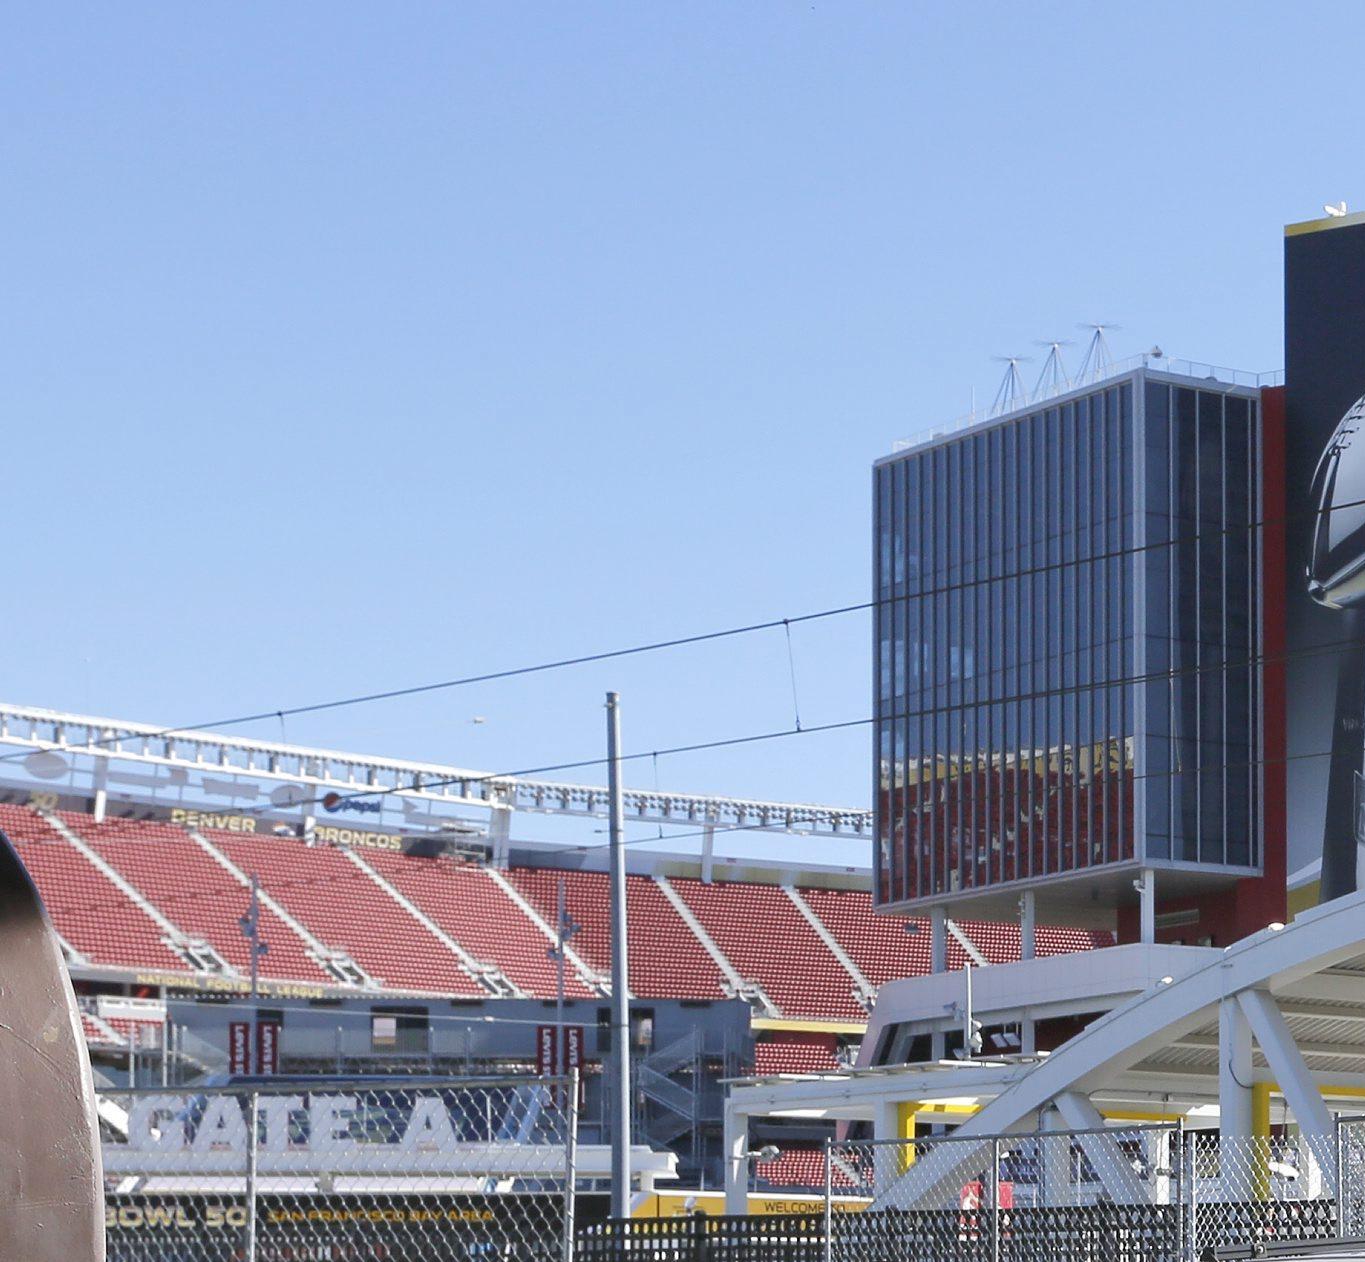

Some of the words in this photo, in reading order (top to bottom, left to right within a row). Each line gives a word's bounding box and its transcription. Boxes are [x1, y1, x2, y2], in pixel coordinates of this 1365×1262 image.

[170, 807, 256, 834] DENVER
[136, 973, 200, 989] NATIONAL
[206, 979, 272, 995] FOOTBLL
[276, 985, 324, 999] LEAGUE
[126, 1095, 359, 1152] GATE
[399, 1095, 460, 1152] A
[205, 1205, 248, 1229] 50
[266, 1209, 304, 1224] SAN
[307, 1209, 405, 1224] FRANCISCO
[409, 1209, 443, 1224] BAY
[446, 1209, 494, 1224] AREA
[764, 1201, 826, 1214] WELCOME
